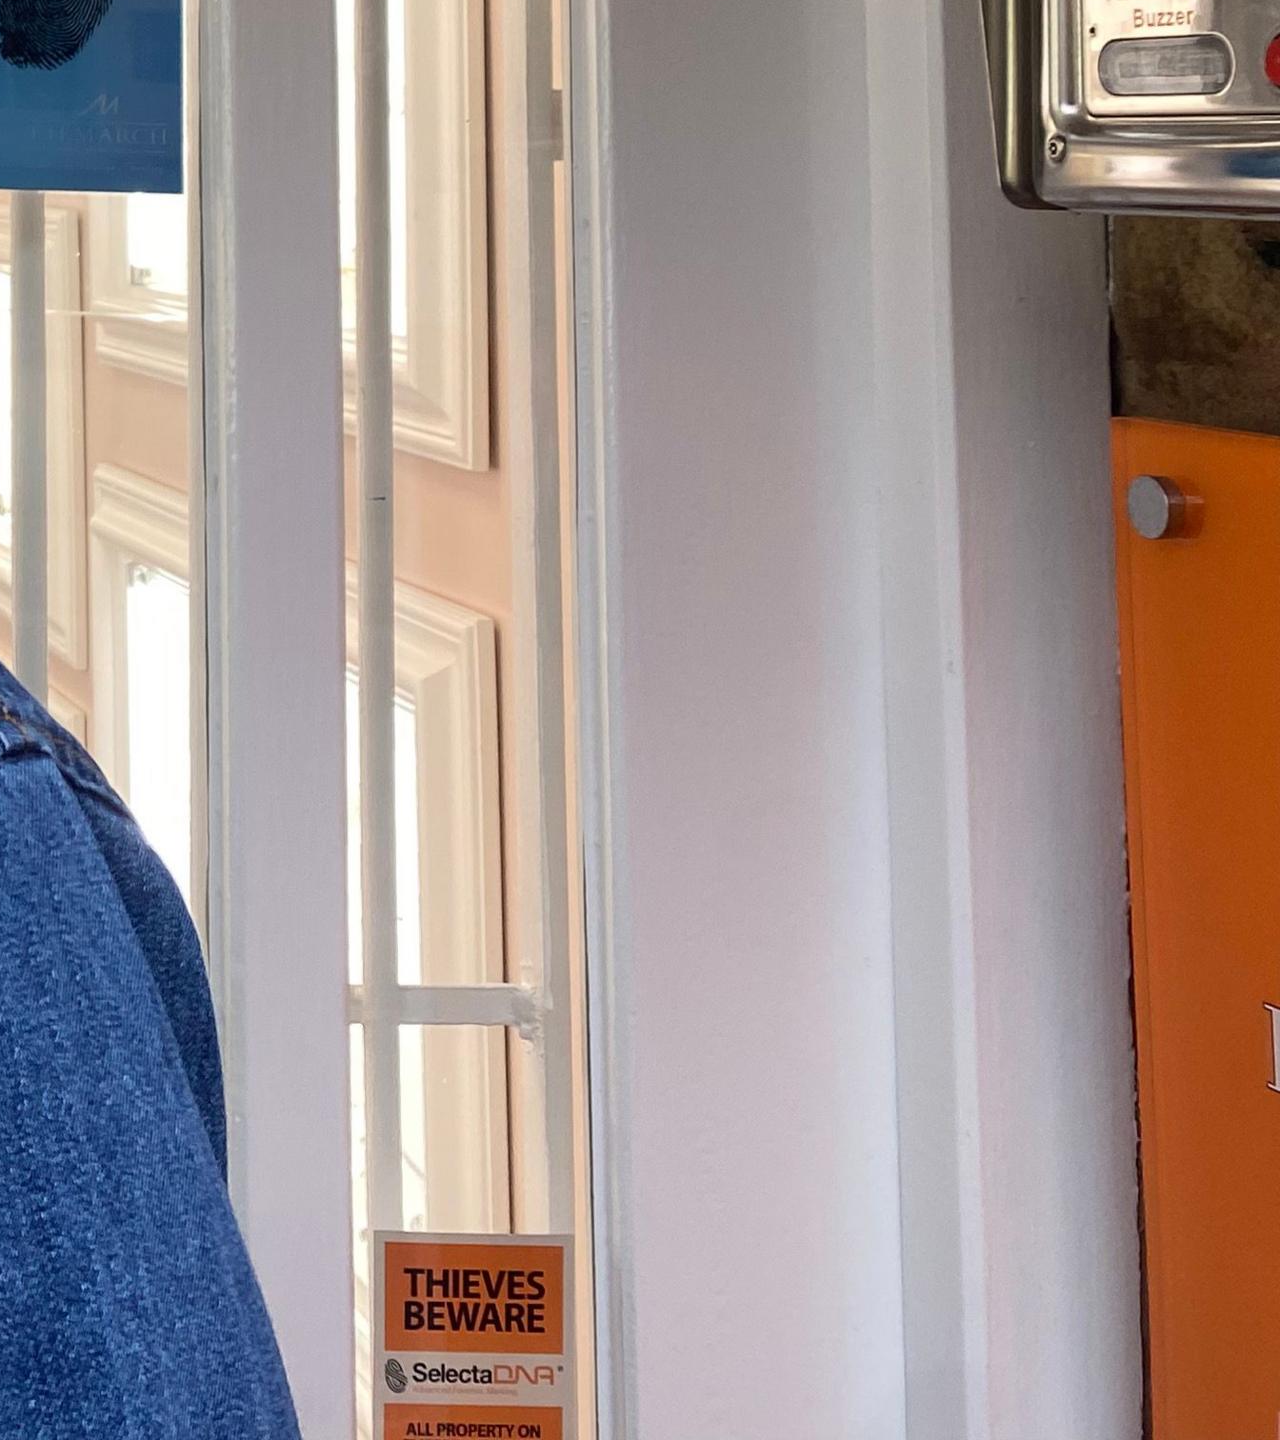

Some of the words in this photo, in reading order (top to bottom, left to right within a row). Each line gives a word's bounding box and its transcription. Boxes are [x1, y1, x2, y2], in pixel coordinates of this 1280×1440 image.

[1133, 9, 1194, 28] Buzzer
[403, 1268, 546, 1300] THIEVES
[404, 1301, 546, 1333] BEWARE
[406, 1422, 433, 1437] ALL
[437, 1423, 515, 1438] PROPERTY
[518, 1424, 542, 1439] ON
